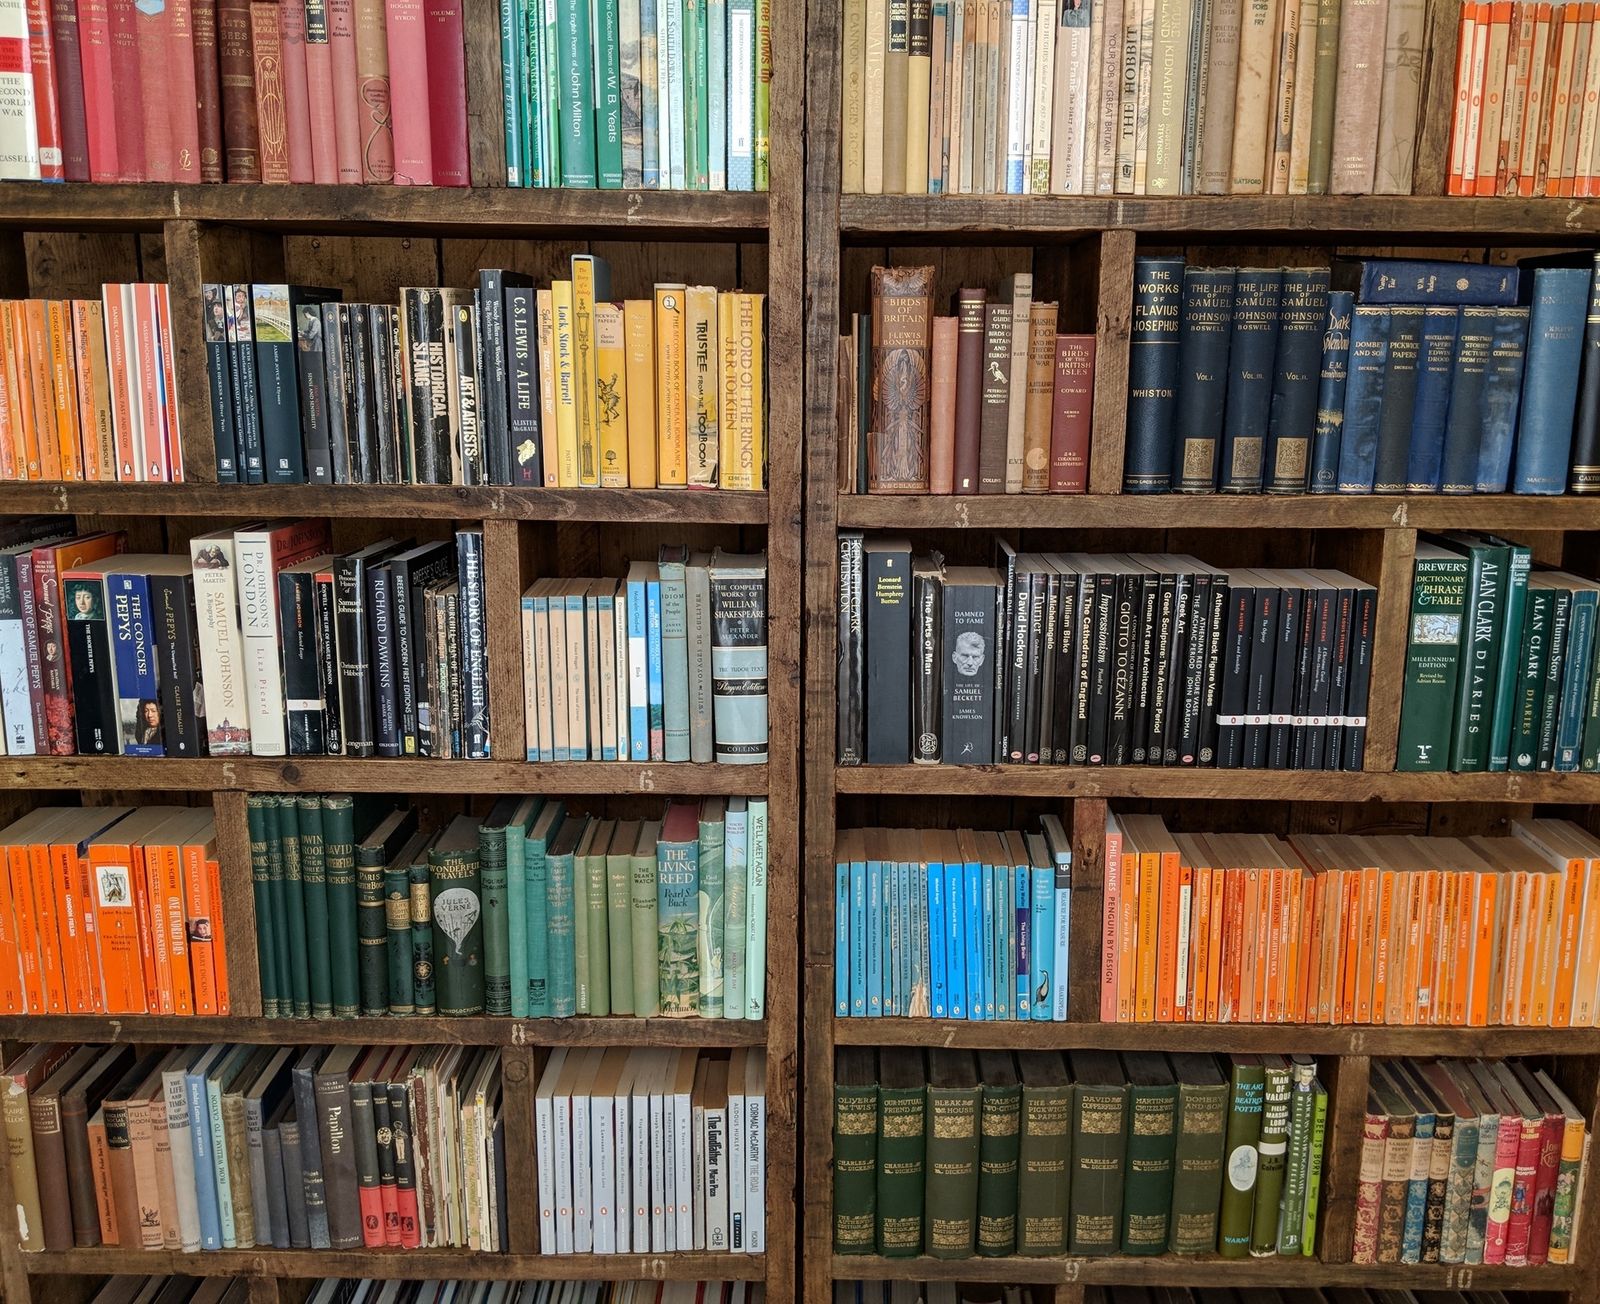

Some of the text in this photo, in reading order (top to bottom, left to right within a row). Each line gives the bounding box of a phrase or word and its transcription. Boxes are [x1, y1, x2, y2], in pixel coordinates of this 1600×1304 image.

[757, 25, 770, 83] grows up
[1123, 27, 1138, 139] THE HOBBIT
[1163, 45, 1173, 117] KIDNAPPED
[572, 69, 582, 138] John Milton
[608, 109, 617, 143] Yeats
[1104, 121, 1112, 157] BRITAIN
[1156, 123, 1164, 165] STEVENSON
[1139, 284, 1179, 293] WORKS
[1188, 299, 1231, 308] SAMUEL
[1236, 298, 1278, 307] SAMUEL
[1282, 298, 1325, 307] SAMUEL
[883, 315, 925, 323] BRITAIN
[1134, 321, 1178, 331] JOSEPHUS
[1135, 306, 1178, 316] FLAVIUS
[1186, 312, 1231, 322] JOHNSON
[1233, 312, 1277, 320] JOHNSON
[1279, 312, 1324, 321] JOHNSON
[413, 342, 430, 386] SLANG
[559, 331, 569, 357] Stock
[429, 342, 446, 418] HISTORICAL
[460, 375, 474, 395] ART
[518, 381, 530, 410] LIFE
[561, 370, 573, 406] Barrel!
[696, 320, 708, 468] TRUSTEE TOOLROOM
[741, 298, 753, 468] THE LORD OF THE RINGS
[725, 374, 737, 430] TOLKIEN
[1418, 562, 1467, 572] BREWER'S
[242, 552, 258, 628] LONDON
[257, 570, 269, 629] JOHNSON'S
[925, 594, 933, 613] The
[1179, 593, 1188, 618] Greek
[1423, 585, 1463, 594] PHRASE
[1432, 596, 1462, 605] FABLE
[115, 594, 132, 641] PEPYS
[466, 551, 484, 706] THE STORY ENGLISH
[925, 617, 933, 639] Arts
[1014, 593, 1028, 669] David Hockney
[1033, 592, 1045, 634] Turner
[1047, 595, 1057, 650] Michelangelo
[1062, 595, 1072, 653] William Blake
[1097, 593, 1112, 663] Impressionism
[24, 590, 41, 689] DIARY SAMUEL PEPYS
[132, 595, 148, 676] THE CONCISE
[214, 592, 234, 707] SAMUEL JOHNSON
[374, 580, 391, 688] RICHARD DAWKINS
[1140, 593, 1156, 708] Roman Art Architecture
[1207, 592, 1224, 707] Athenian Black Figure Vases
[1469, 562, 1498, 734] ALAN CLARK DIARIES
[1547, 596, 1568, 682] The Human Story
[398, 604, 412, 714] GUIDE MODERN EDITIONS
[1078, 597, 1093, 720] The Cathedrals England
[1114, 602, 1131, 721] GIOTTO CÉZANNE
[1153, 592, 1172, 734] Greek Archaic Period
[1522, 596, 1546, 736] ALAN CLARK DIARIES
[222, 763, 236, 785] 5
[435, 870, 475, 879] TRAVELS
[658, 861, 696, 872] LIVING
[665, 849, 687, 860] THE
[660, 873, 694, 884] REED
[1108, 861, 1117, 892] BAINES
[441, 904, 471, 912] VERNE
[668, 898, 689, 908] Buck
[1107, 896, 1115, 937] PENGUIN
[1272, 1076, 1289, 1085] MAN
[327, 1106, 343, 1154] Papillon
[750, 1103, 759, 1130] CORMAC
[1270, 1119, 1285, 1127] LORD
[1312, 1118, 1325, 1175] BEE BORN
